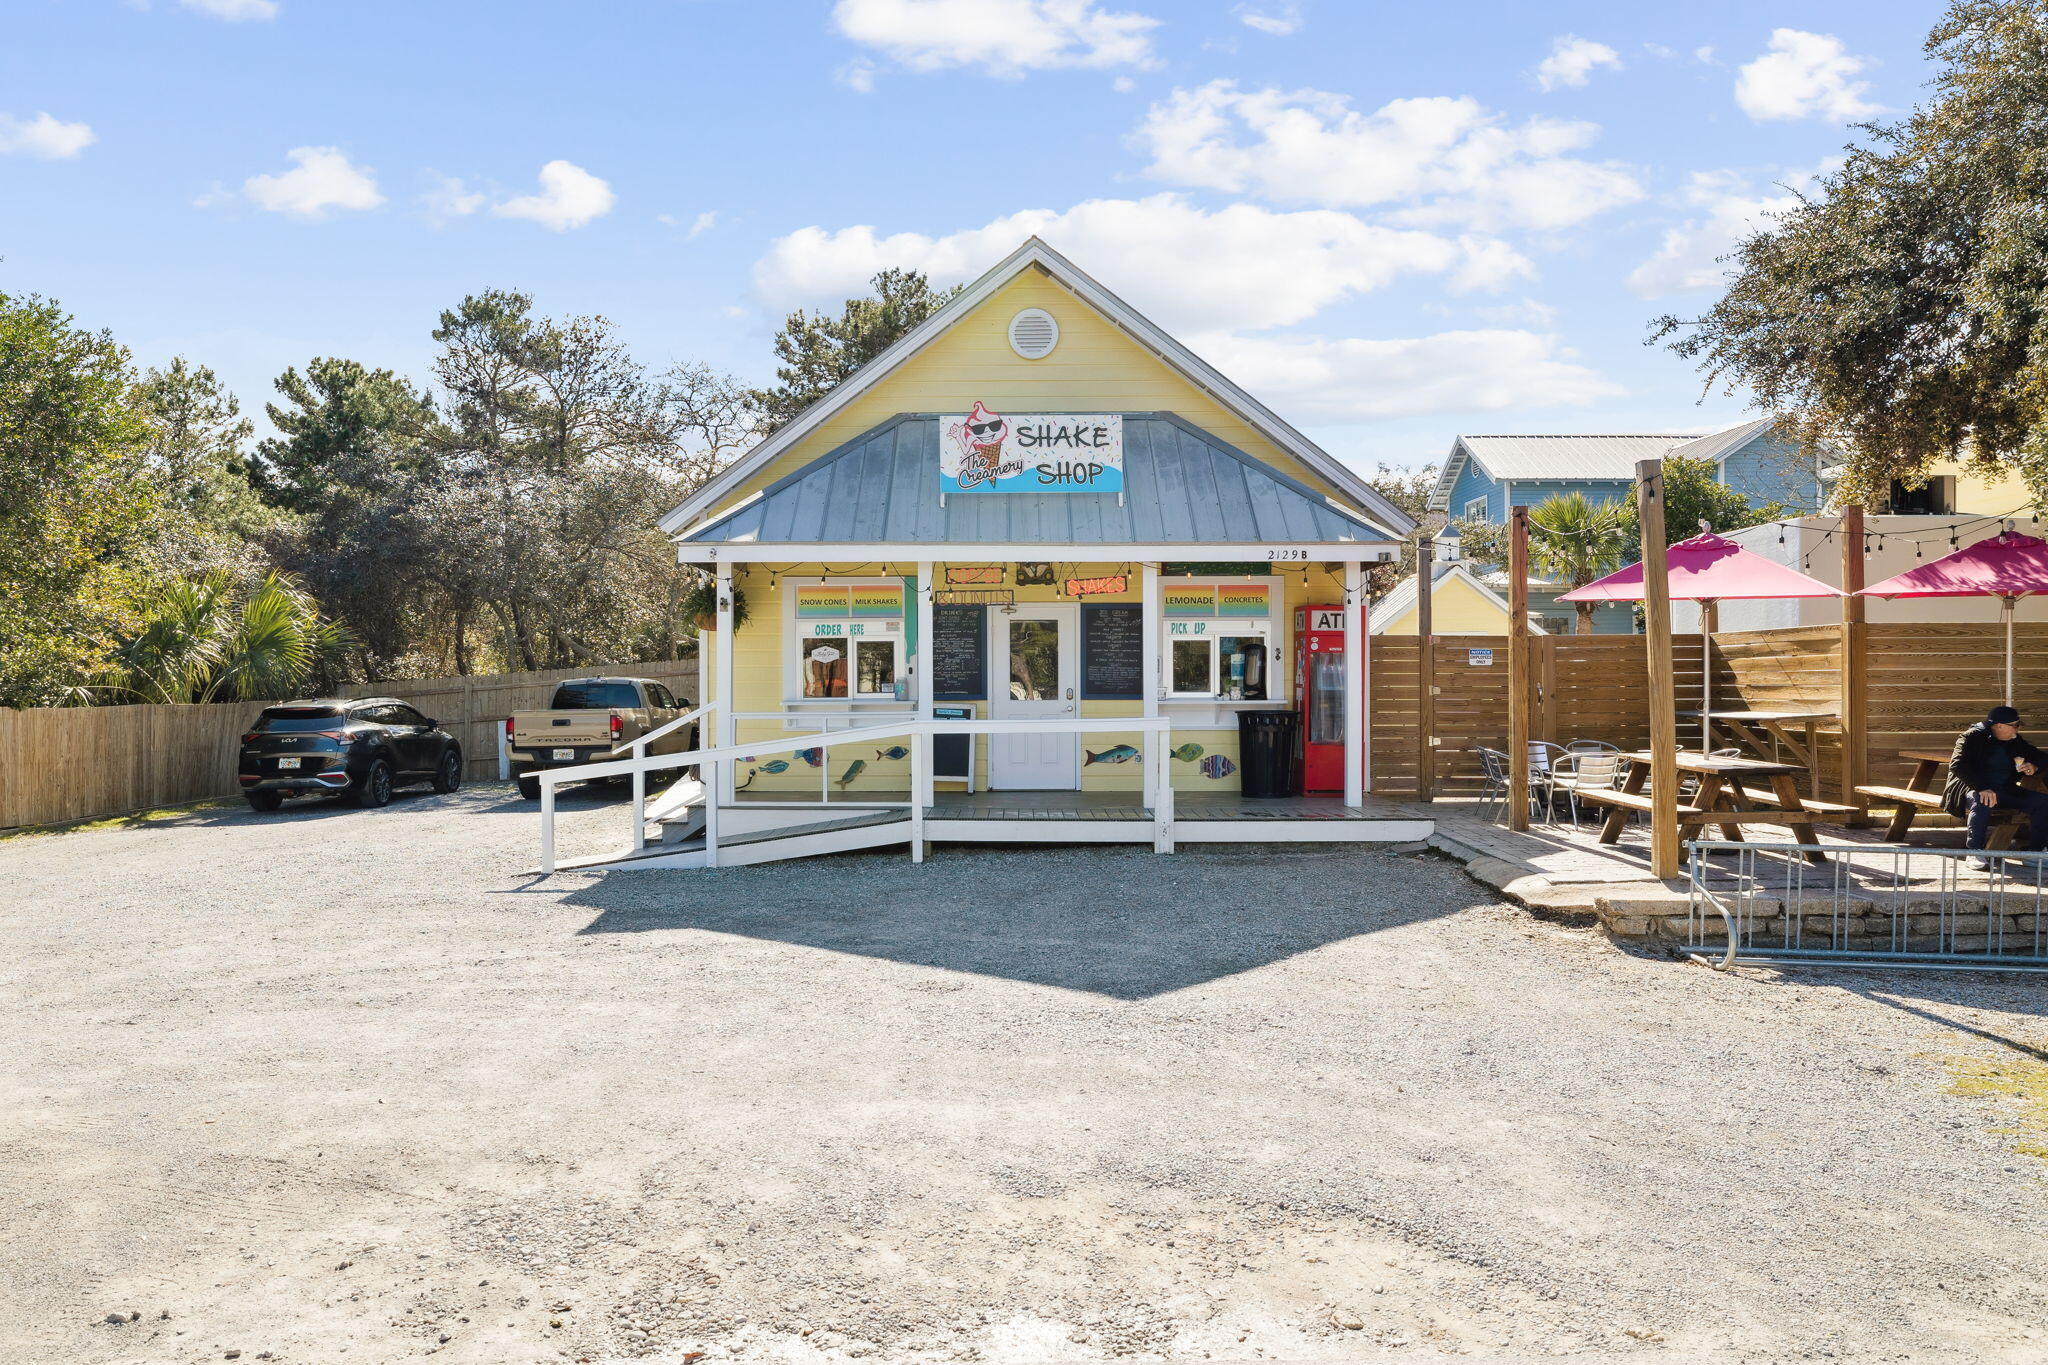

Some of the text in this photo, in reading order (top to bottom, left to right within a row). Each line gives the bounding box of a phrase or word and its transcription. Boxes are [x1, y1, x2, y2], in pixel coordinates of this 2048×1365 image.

[1017, 425, 1109, 447] SHAKE
[961, 452, 988, 470] The
[958, 459, 1024, 488] Creamery
[1036, 461, 1104, 484] SHOP
[1068, 576, 1125, 596] SHAKES
[1165, 596, 1214, 605] LEMONADE
[1224, 596, 1263, 604] CONCRETES
[1171, 622, 1206, 634] PICK UP
[1317, 613, 1345, 629] AT
[815, 624, 865, 636] ORDER HERE
